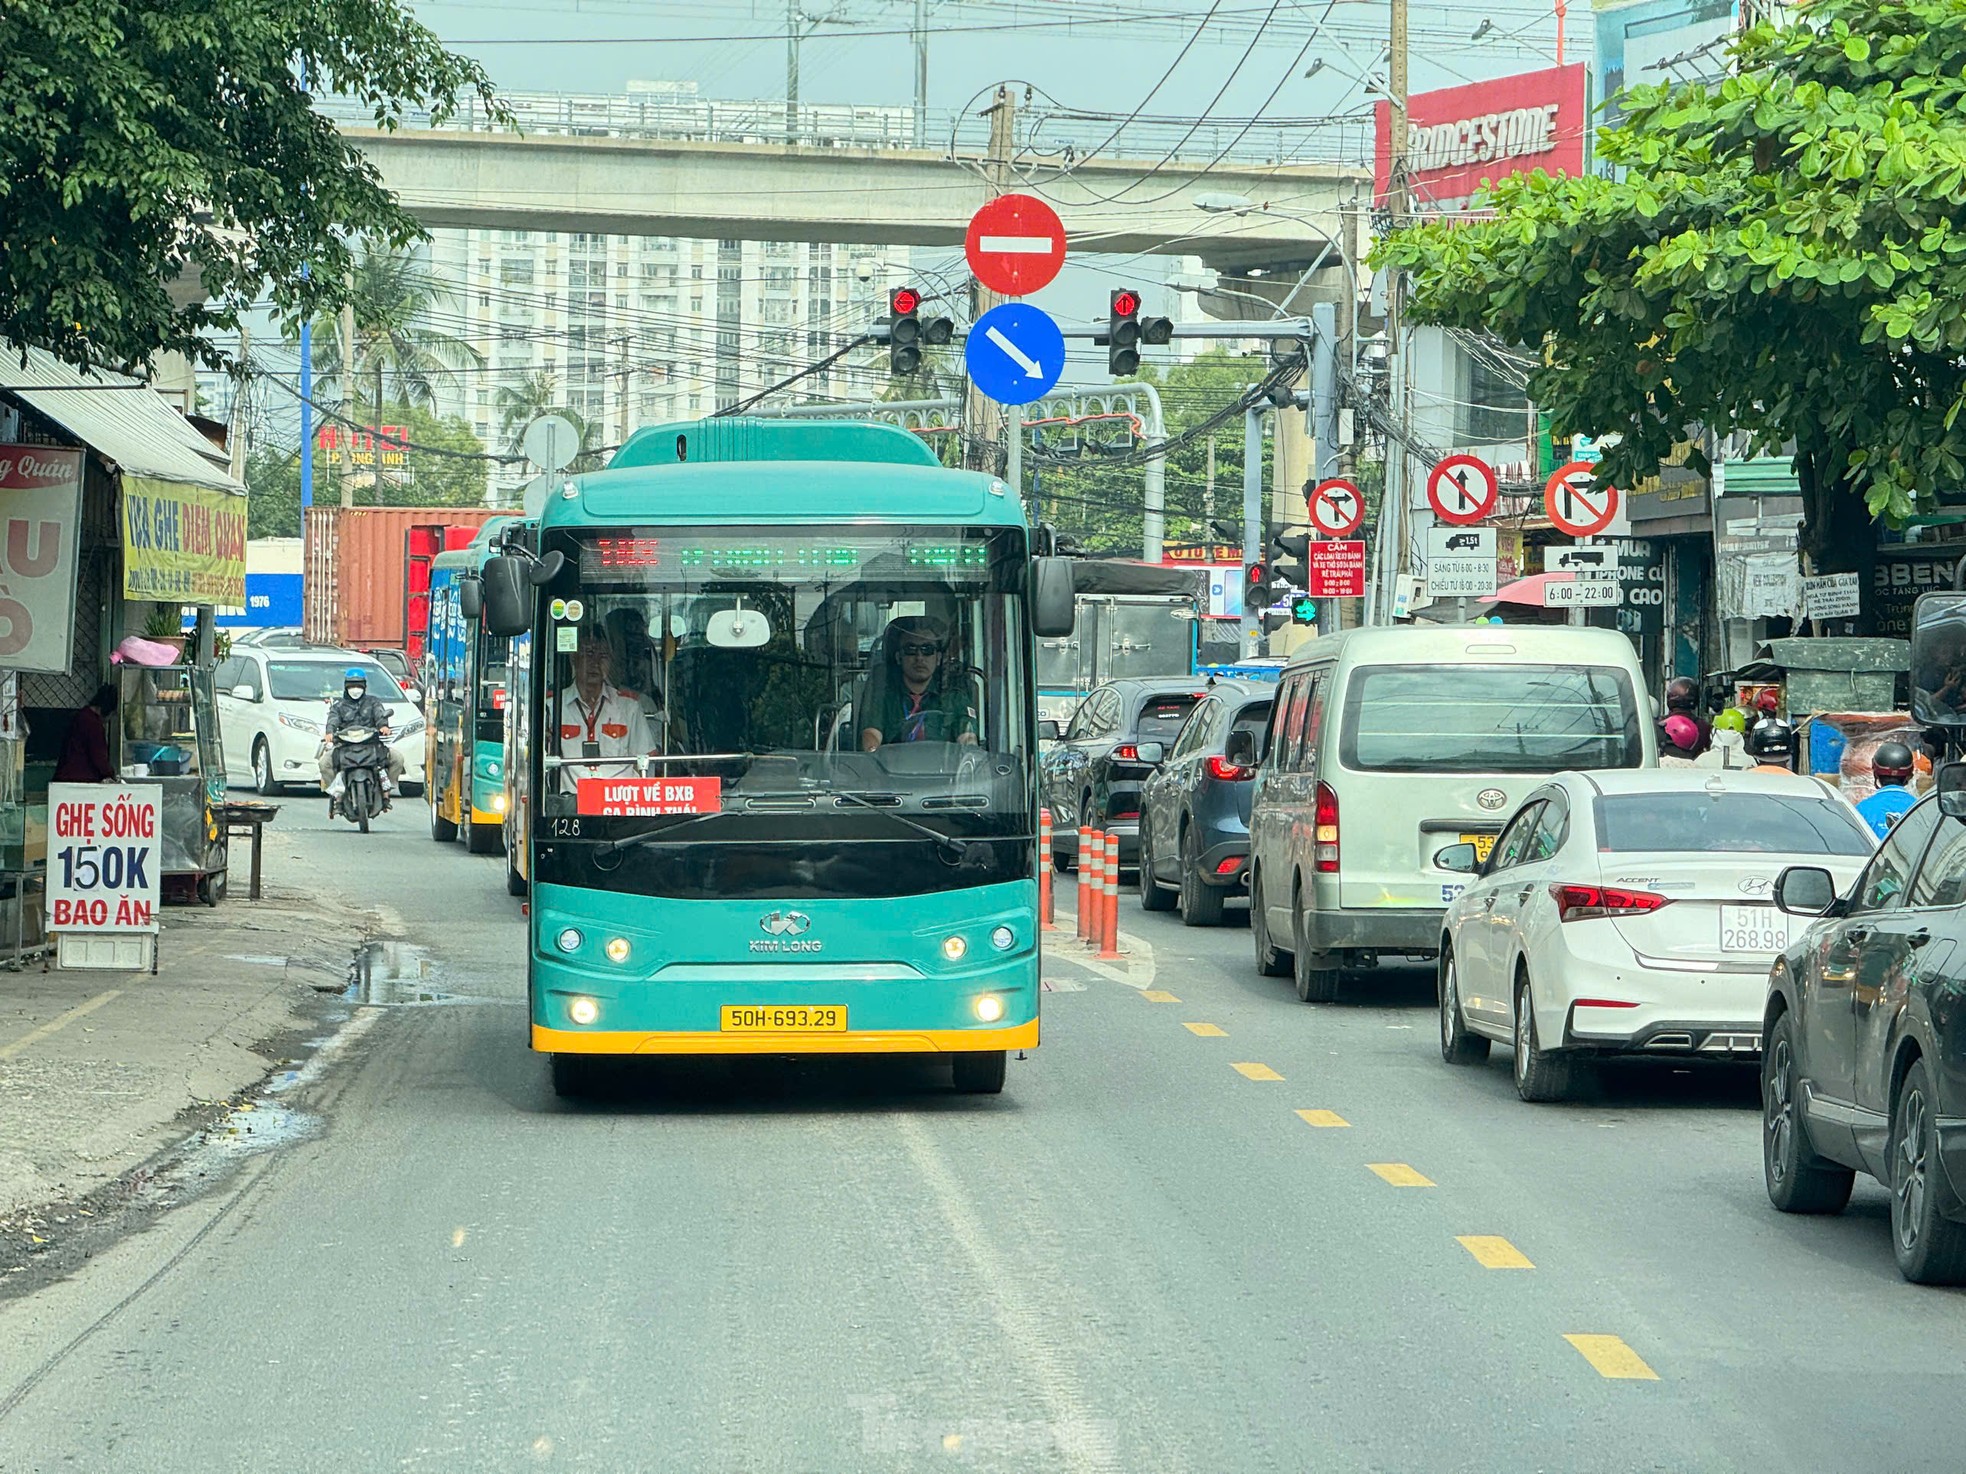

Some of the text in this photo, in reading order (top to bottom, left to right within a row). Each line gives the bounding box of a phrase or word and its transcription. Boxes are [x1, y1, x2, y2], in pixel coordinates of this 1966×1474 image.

[17, 455, 73, 480] Quán
[1612, 539, 1651, 557] MUA
[249, 595, 270, 608] 1976
[1550, 587, 1572, 600] 6:00
[1584, 586, 1613, 599] 22:00
[1629, 587, 1663, 605] CAO
[604, 781, 694, 805] LƯỢT VỀ BXB
[56, 793, 155, 844] GHẸ SỐNG
[551, 818, 581, 837] 128
[57, 845, 150, 891] 150K
[54, 894, 151, 927] BAO ĂN
[1736, 908, 1773, 929] 51H
[782, 940, 823, 953] LONG
[1724, 929, 1786, 950] 268.98
[732, 1010, 836, 1027] 50H-693.29
